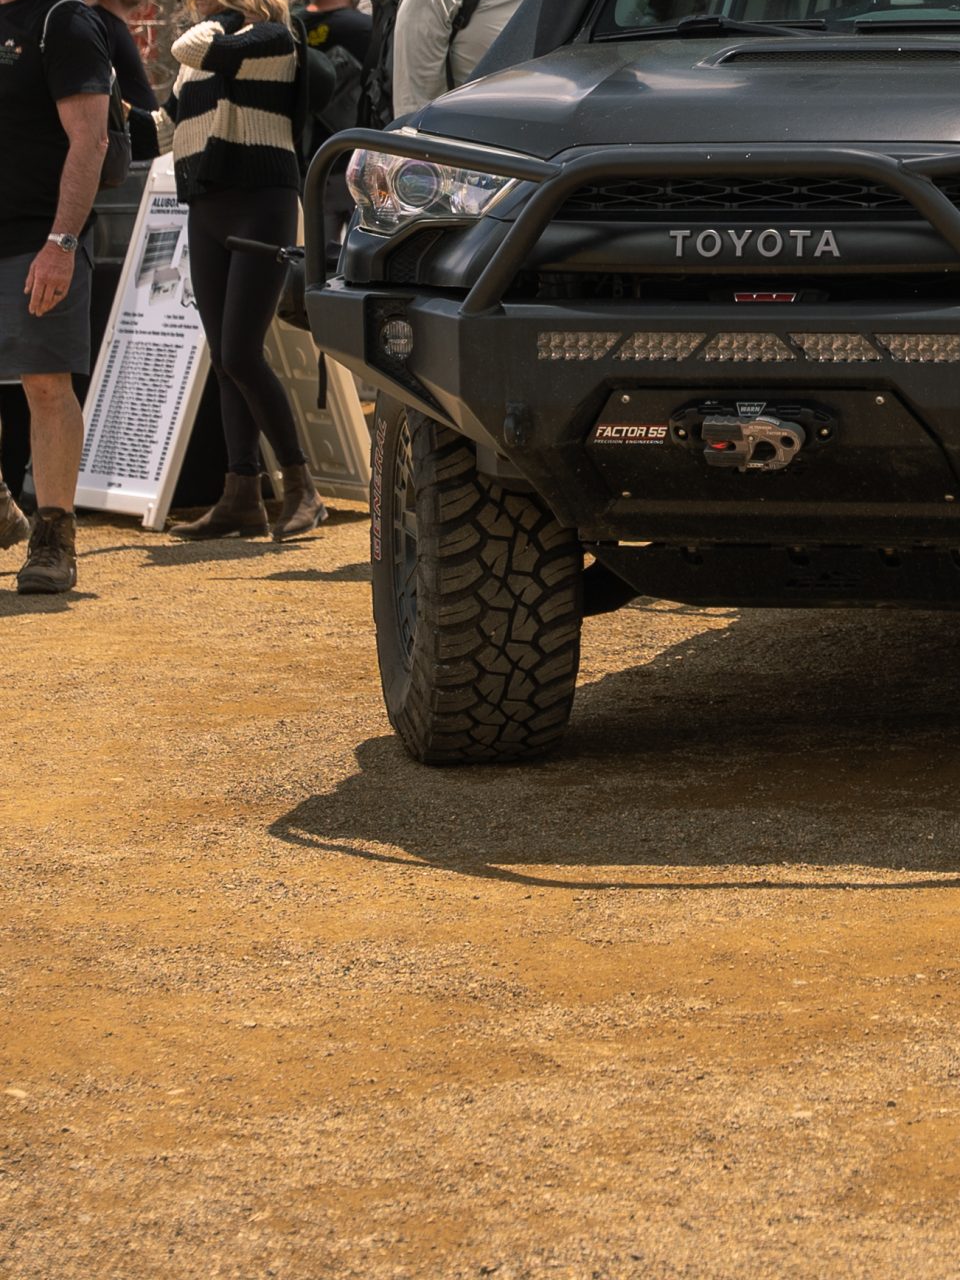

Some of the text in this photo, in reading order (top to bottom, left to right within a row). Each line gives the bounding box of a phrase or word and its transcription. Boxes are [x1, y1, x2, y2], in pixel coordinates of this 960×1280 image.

[669, 229, 841, 258] TOYOTA
[595, 426, 667, 437] FACTOR 55
[373, 419, 387, 561] GENERAL
